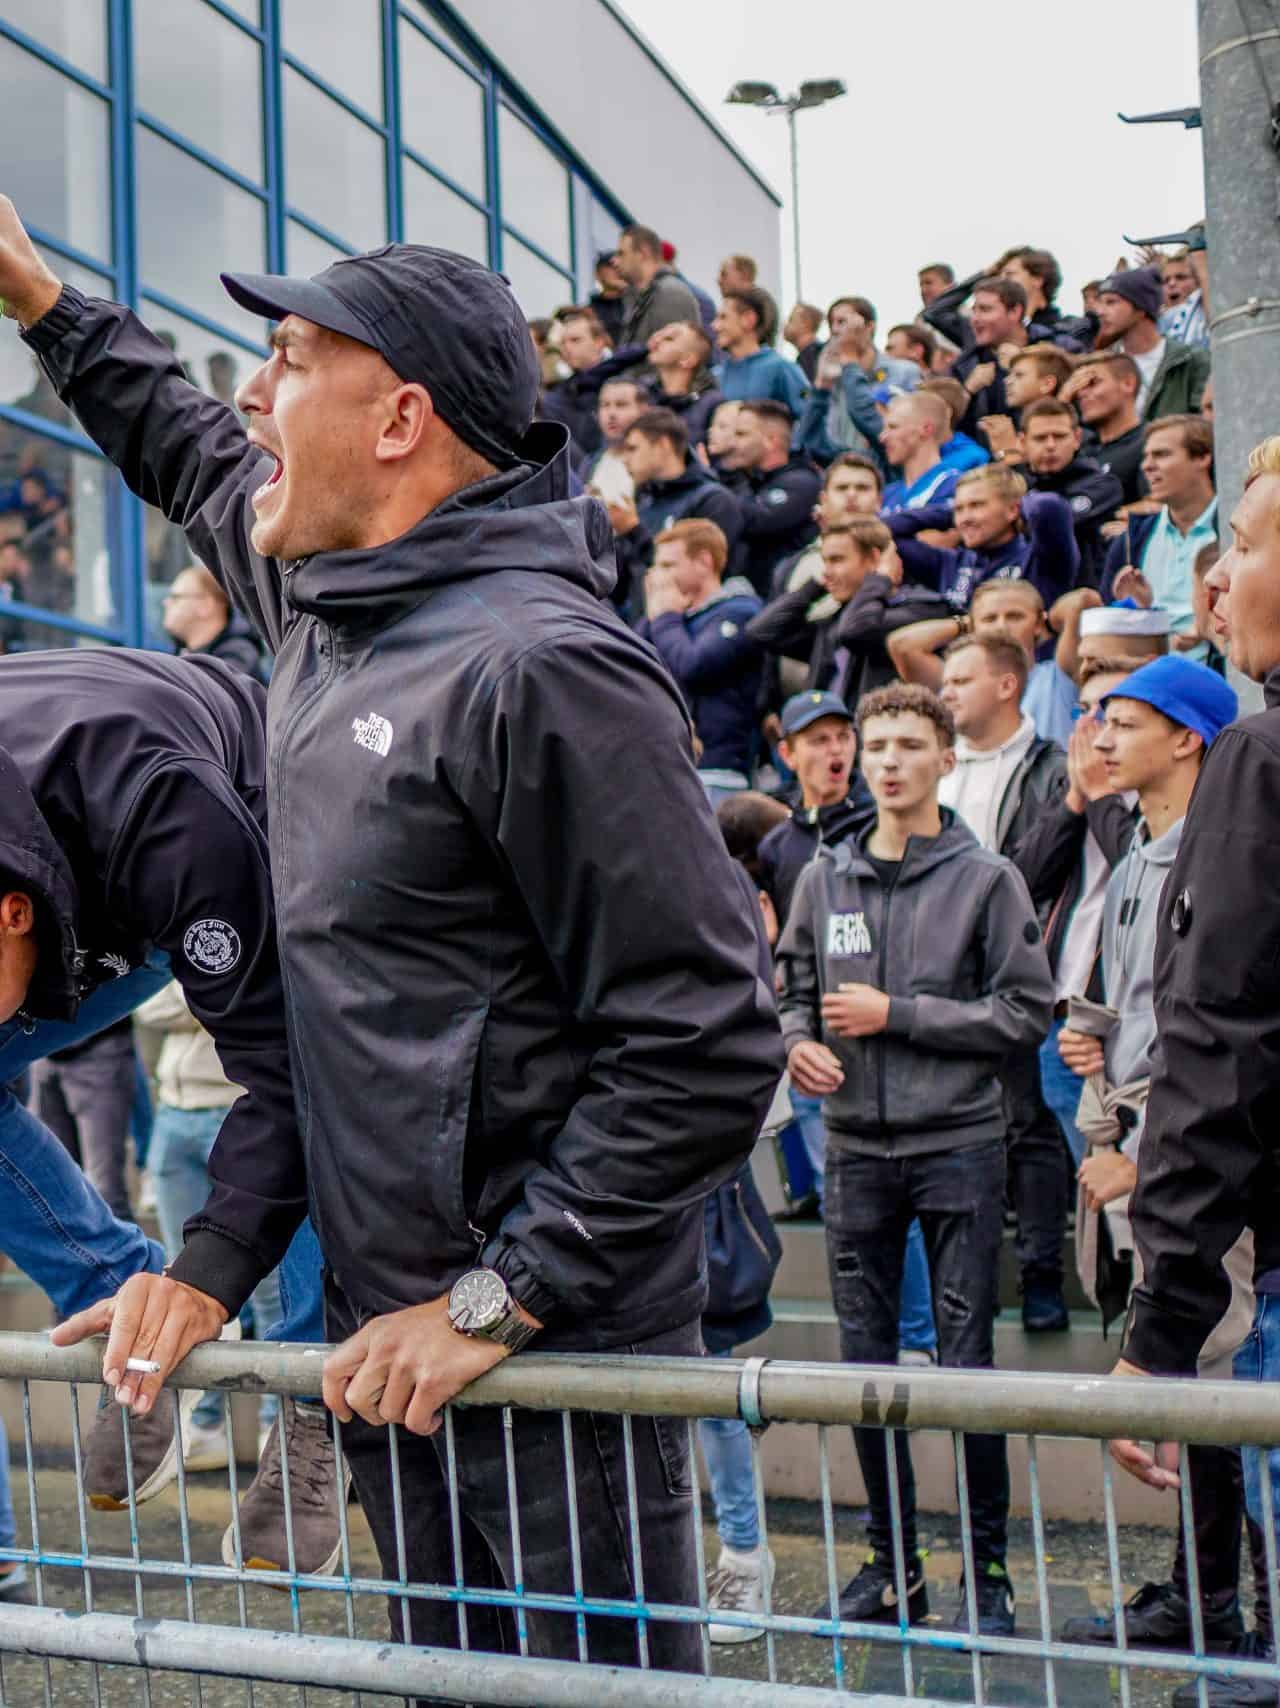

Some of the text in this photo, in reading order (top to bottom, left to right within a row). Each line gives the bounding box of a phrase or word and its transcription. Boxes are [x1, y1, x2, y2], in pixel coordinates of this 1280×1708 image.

[369, 712, 385, 728] THE
[352, 718, 380, 740] NORTH
[354, 734, 377, 751] FACE
